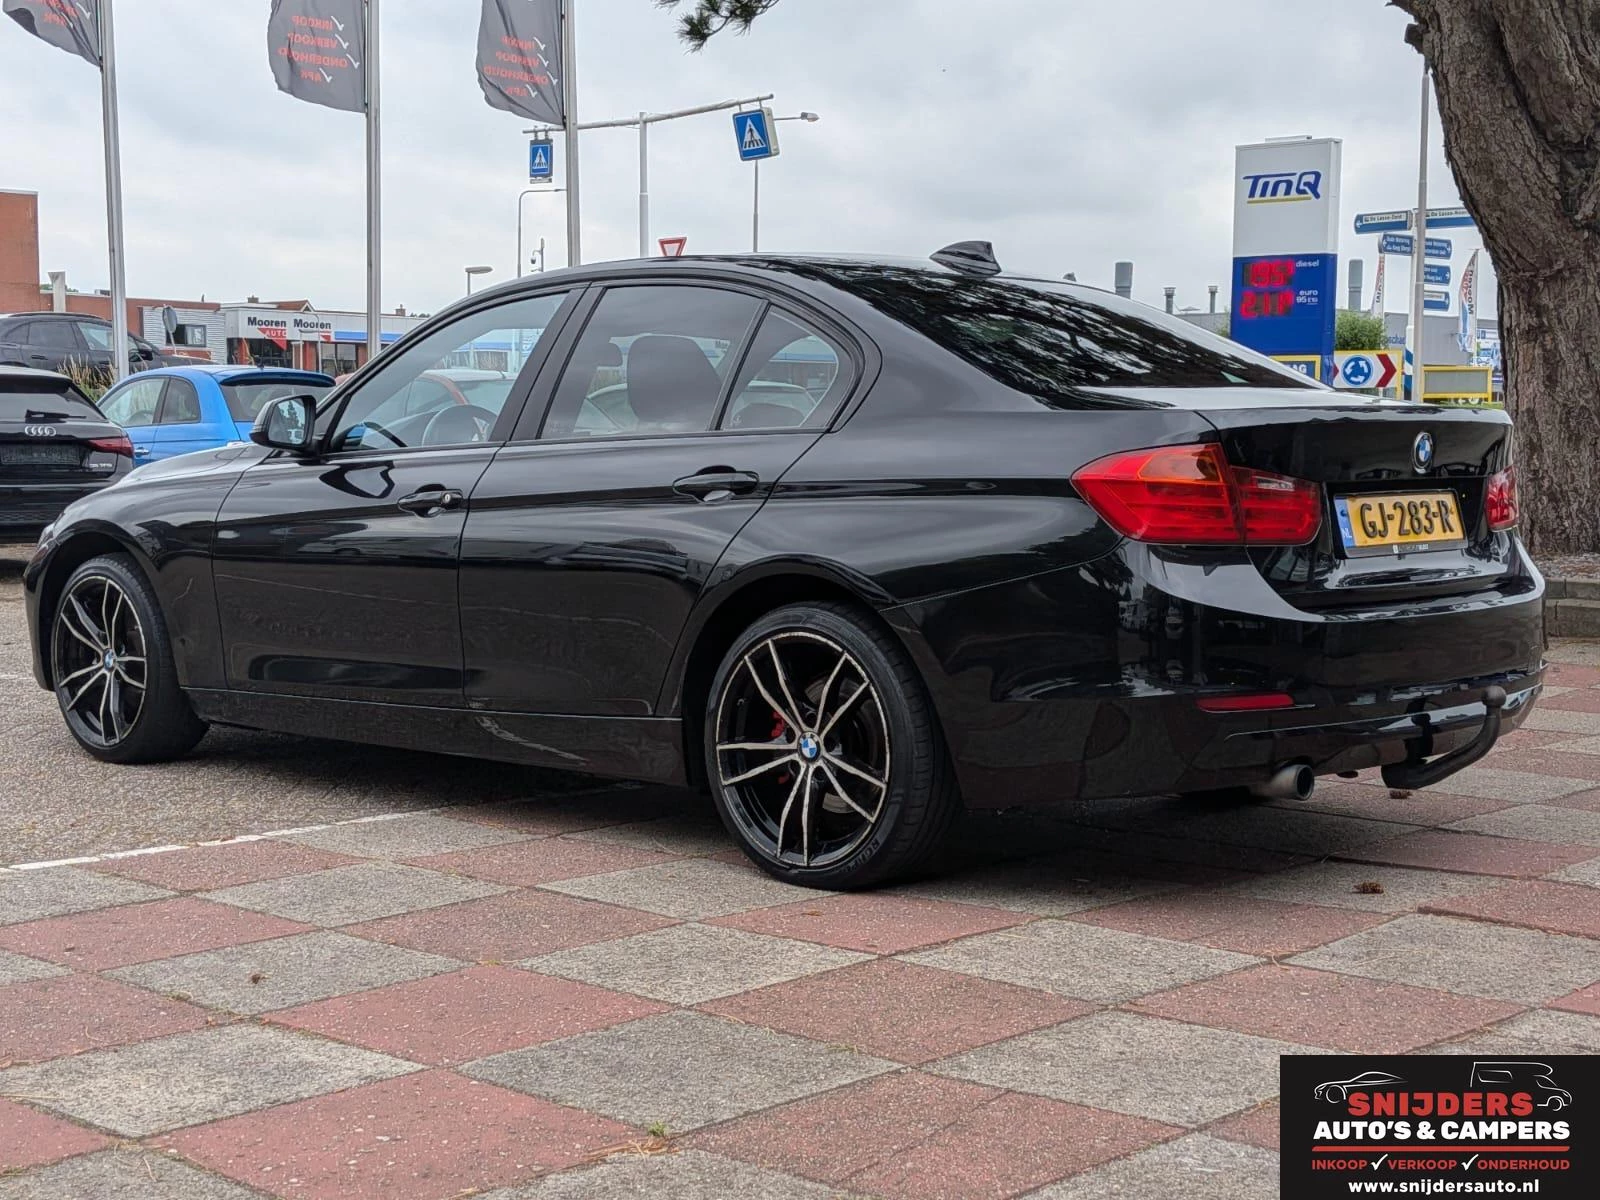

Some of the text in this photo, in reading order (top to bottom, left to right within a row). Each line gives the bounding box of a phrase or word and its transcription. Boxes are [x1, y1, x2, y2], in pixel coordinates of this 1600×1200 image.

[1296, 260, 1320, 268] diesel
[247, 316, 287, 327] Mooren
[293, 319, 332, 329] Mooren
[1360, 500, 1454, 539] GJ-283-R
[1341, 527, 1352, 539] NL
